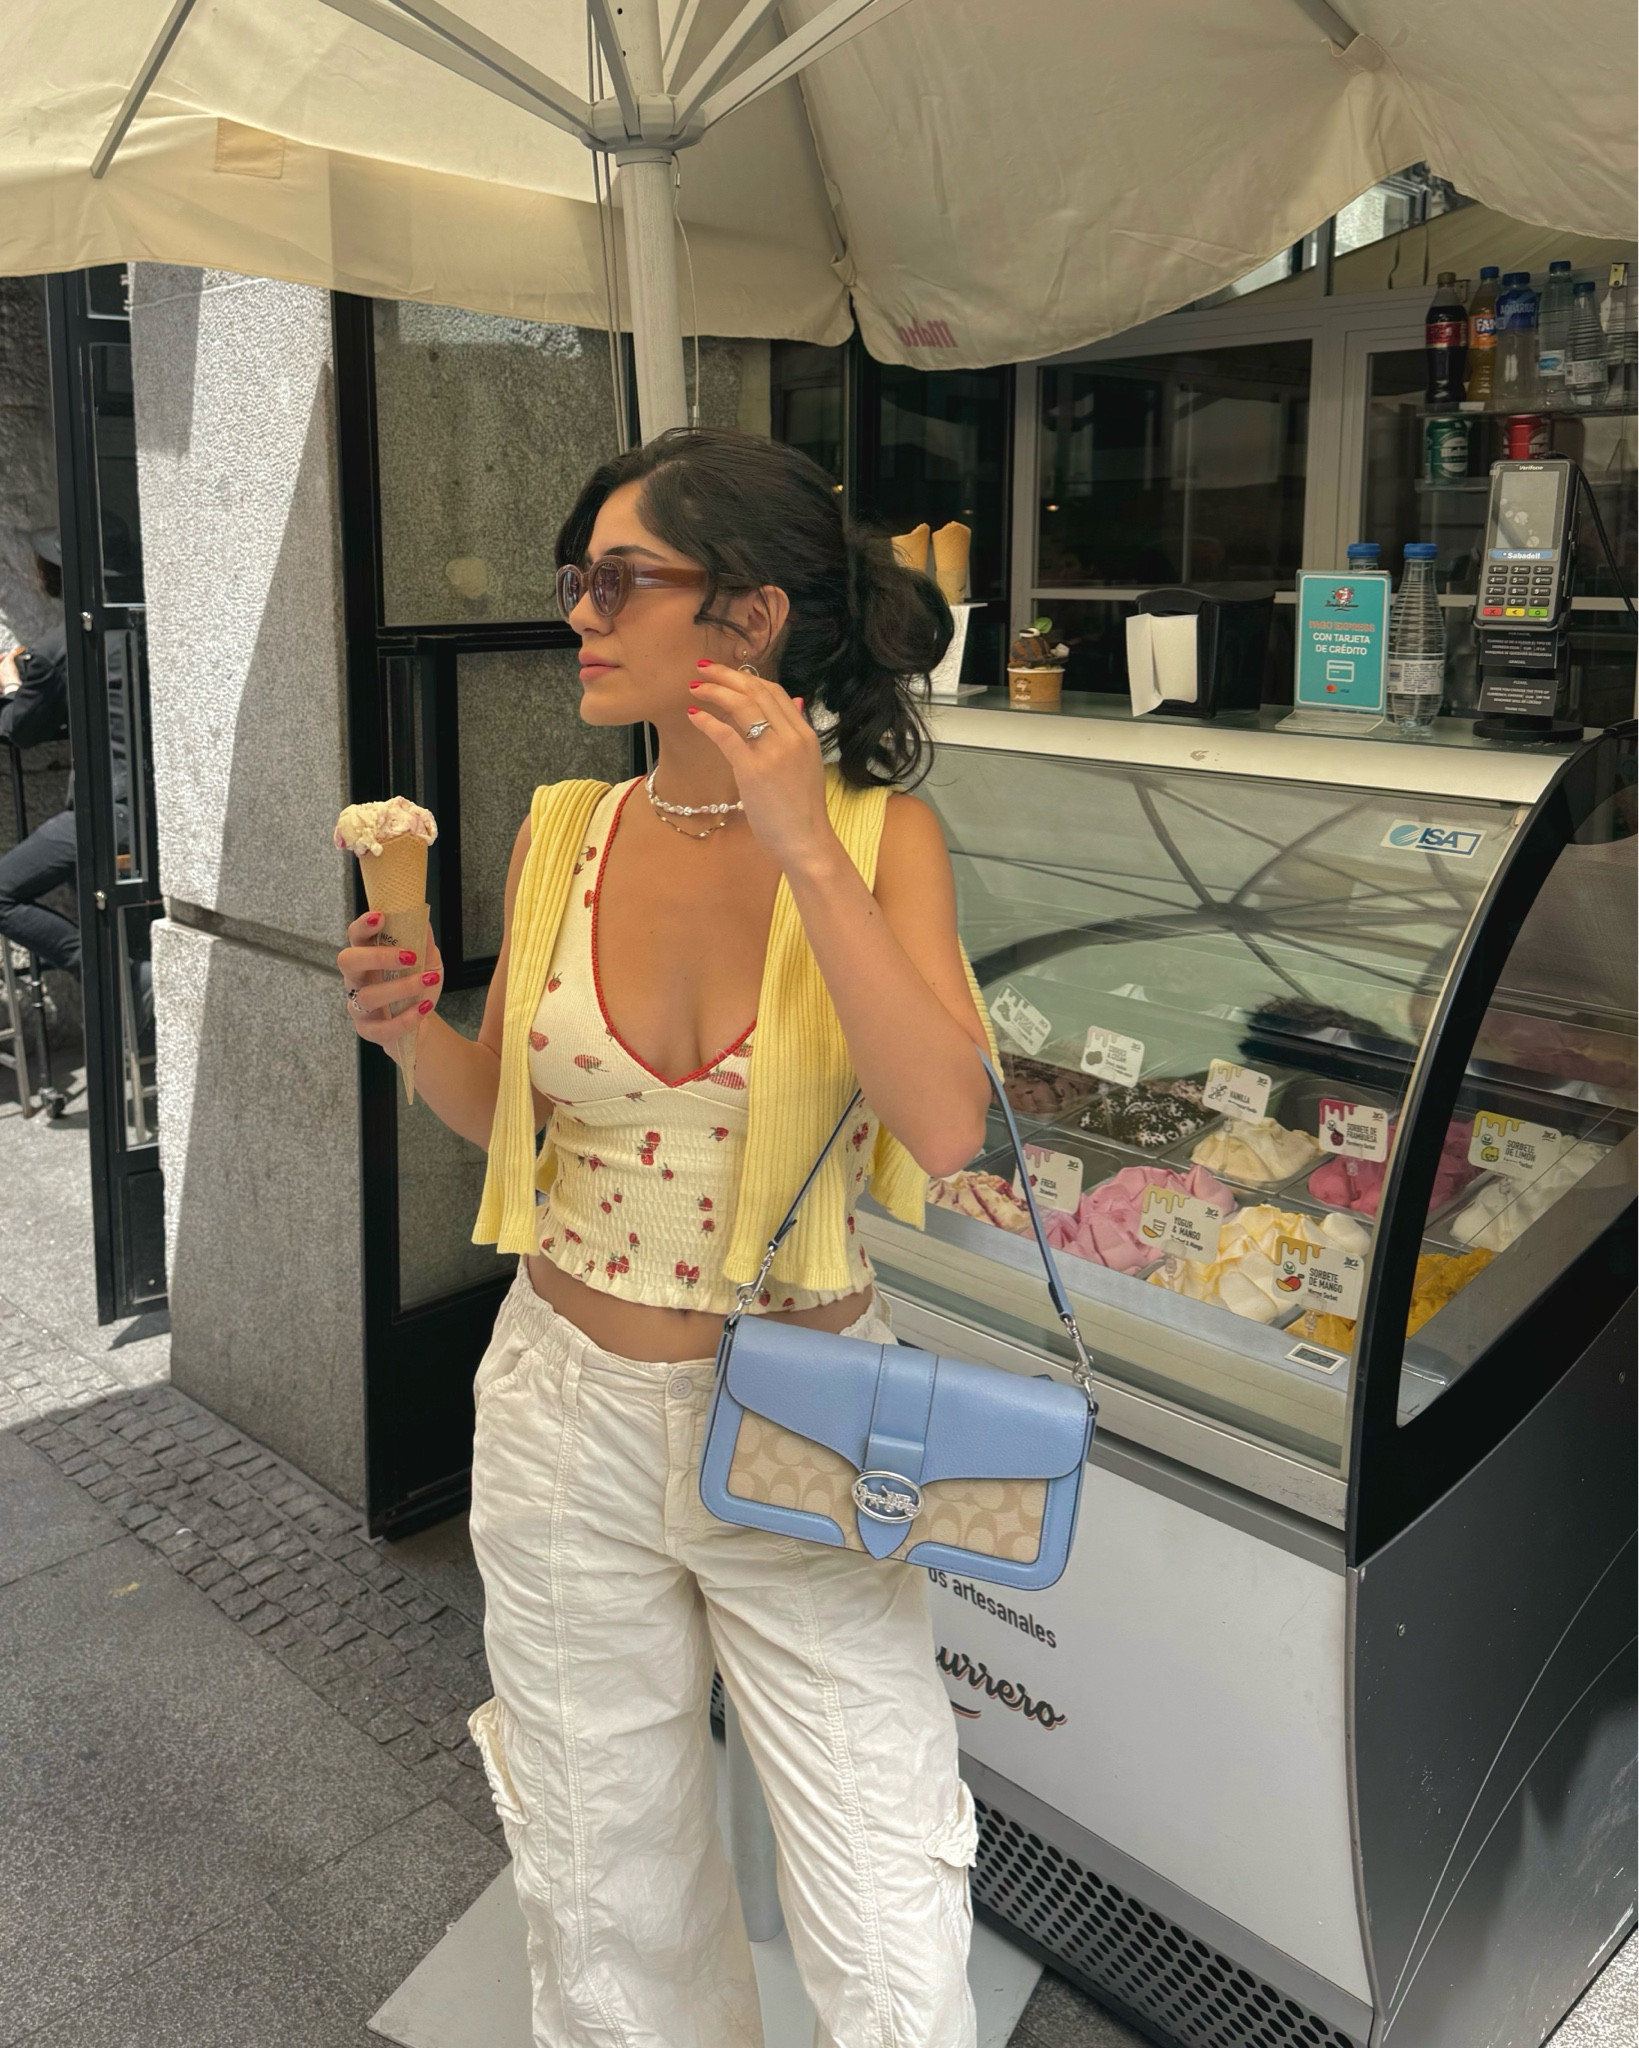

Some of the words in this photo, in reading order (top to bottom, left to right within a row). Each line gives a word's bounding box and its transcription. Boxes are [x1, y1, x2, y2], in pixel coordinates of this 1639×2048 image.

[1476, 317, 1496, 334] FAN
[1313, 632, 1332, 642] CON
[1334, 633, 1371, 644] TARJETA
[1315, 644, 1327, 653] DE
[1329, 643, 1368, 655] CRÉDITO
[1418, 827, 1458, 849] ISA
[1505, 1147, 1513, 1157] DE
[1507, 1139, 1536, 1154] SORBETE
[1178, 1227, 1201, 1241] MANGO
[1309, 1267, 1339, 1283] SORBETE
[1308, 1276, 1318, 1287] DE
[1318, 1279, 1343, 1294] MANGO
[928, 1567, 948, 1588] os
[953, 1579, 1057, 1648] artesanales
[936, 1645, 1068, 1731] urrero
